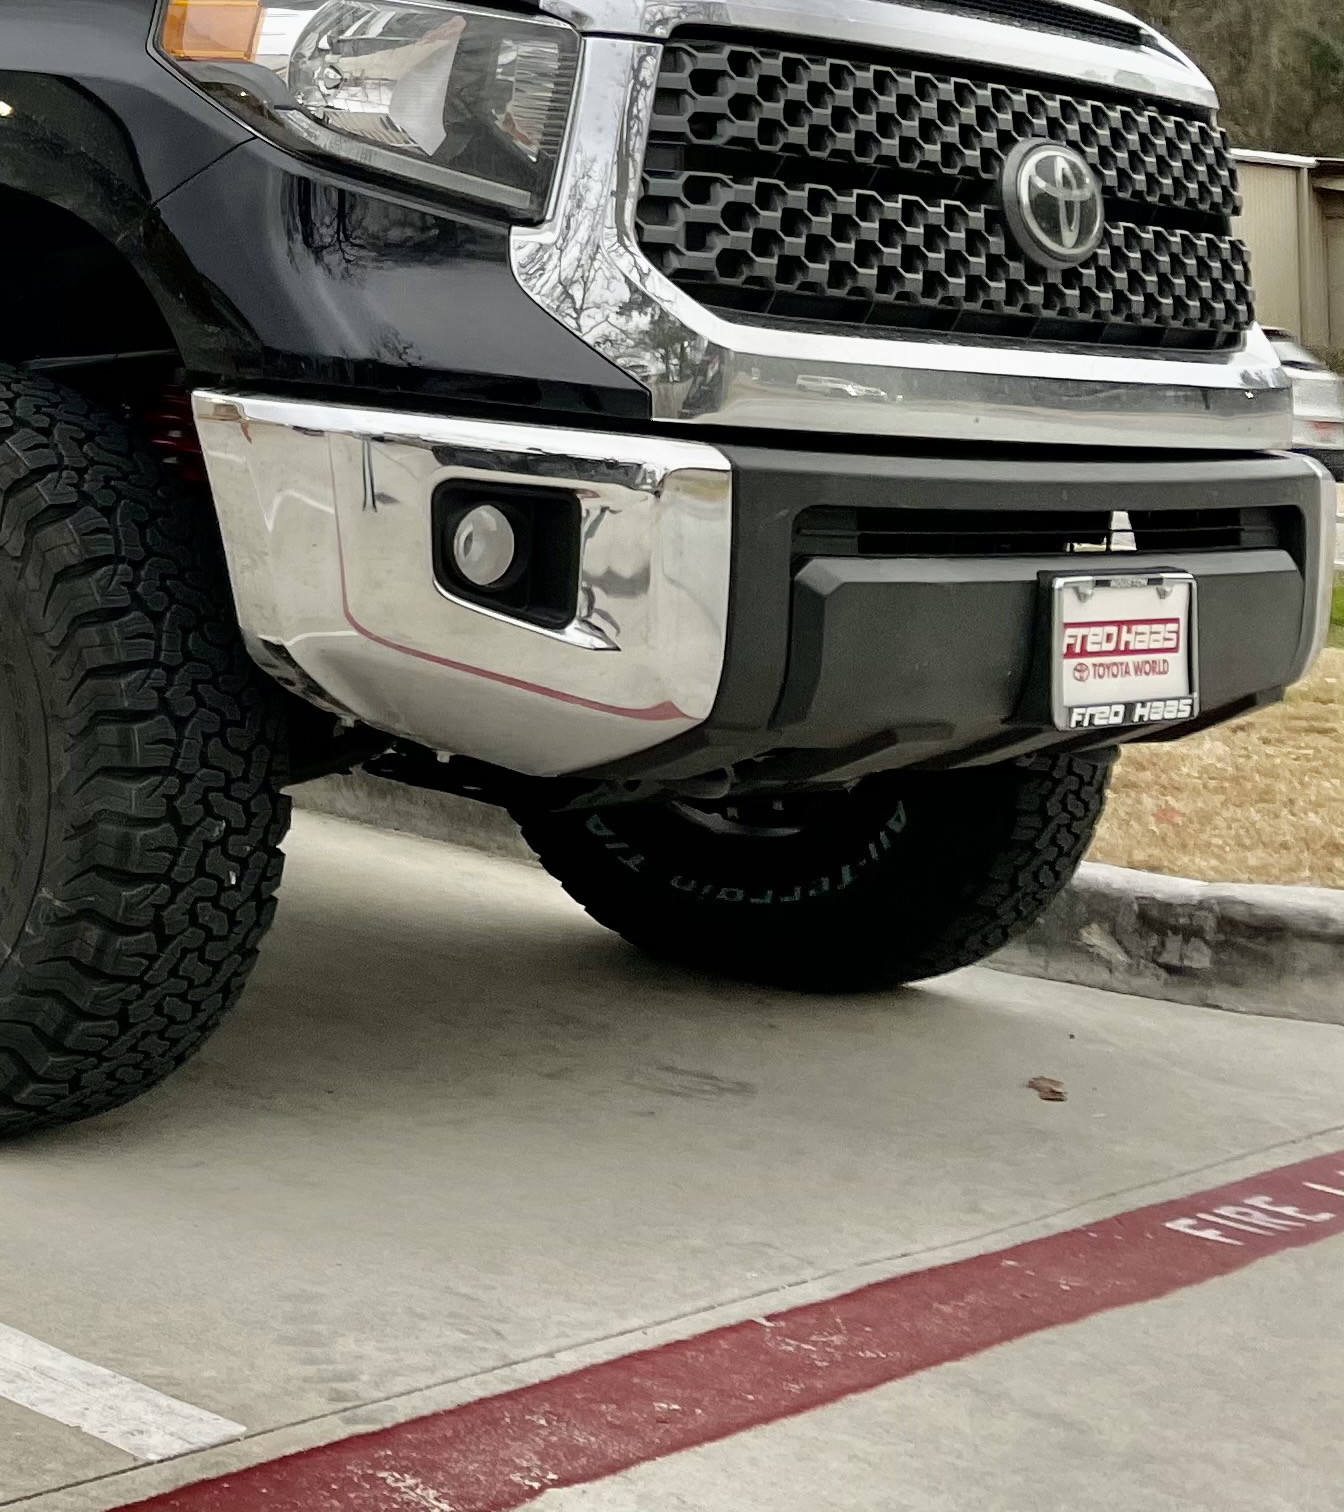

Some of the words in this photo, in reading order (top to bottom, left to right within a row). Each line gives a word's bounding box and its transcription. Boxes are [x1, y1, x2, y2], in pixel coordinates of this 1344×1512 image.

[1092, 662, 1131, 679] TOYOTA
[1132, 659, 1170, 676] WORLD
[1164, 1194, 1336, 1246] FIRE
